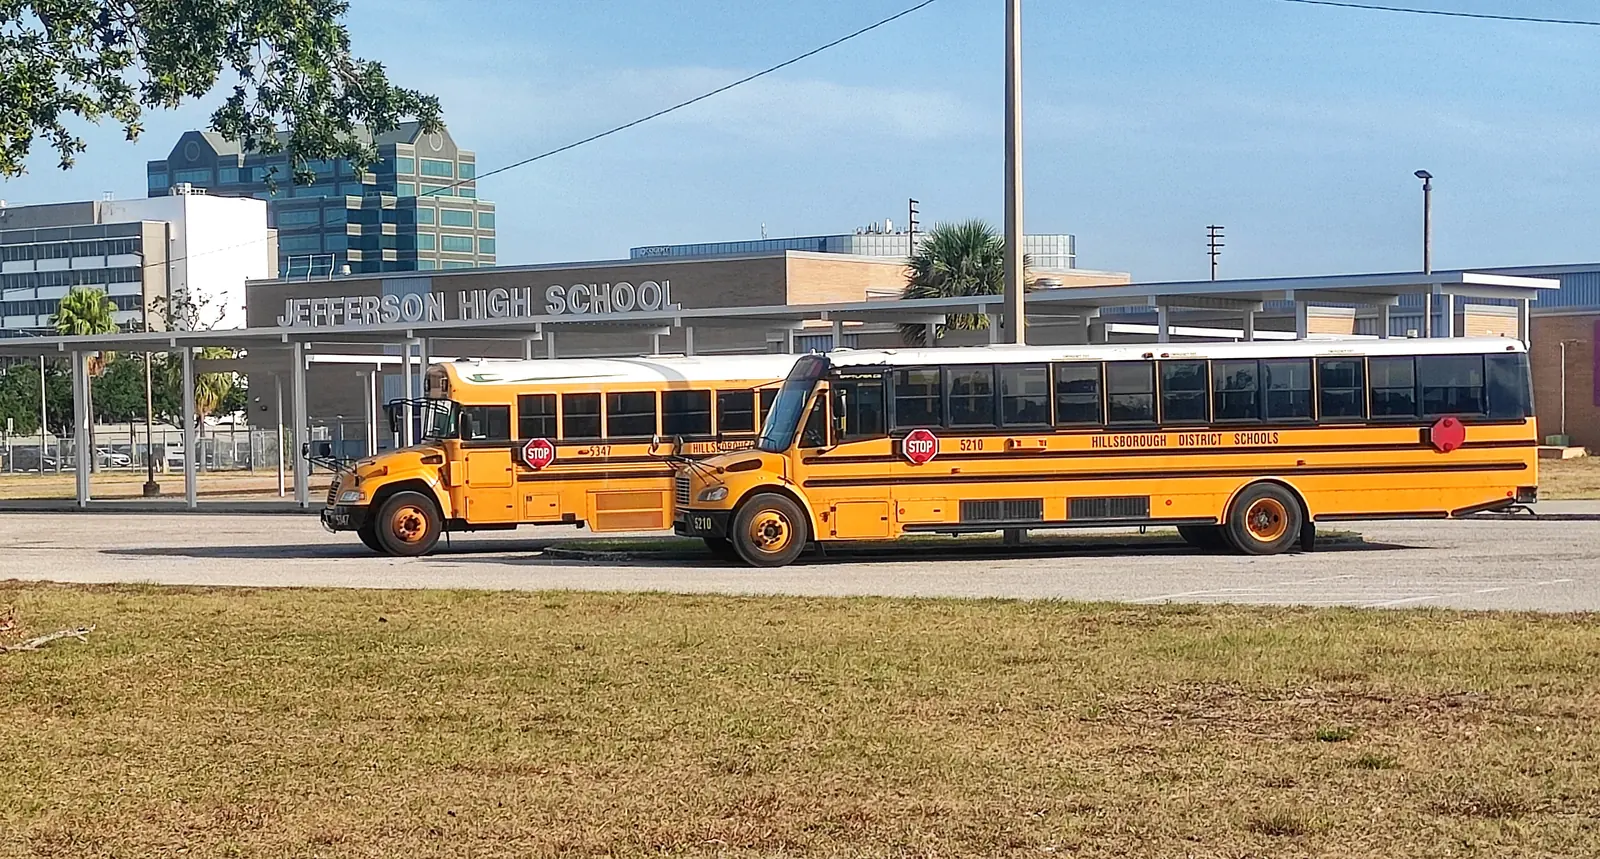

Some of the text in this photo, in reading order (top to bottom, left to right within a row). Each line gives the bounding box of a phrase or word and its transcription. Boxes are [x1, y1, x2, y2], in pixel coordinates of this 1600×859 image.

[276, 279, 682, 328] JEFFERSON HIGH SCHOOL
[908, 440, 933, 453] STOP
[960, 439, 984, 452] 5210
[1091, 432, 1279, 448] HILLSBOROUGH DISTRICT SCHOOLS
[527, 447, 550, 460] STOP
[589, 445, 612, 457] 5347
[692, 440, 755, 454] HILLSBOROUG
[694, 517, 712, 530] 5210
